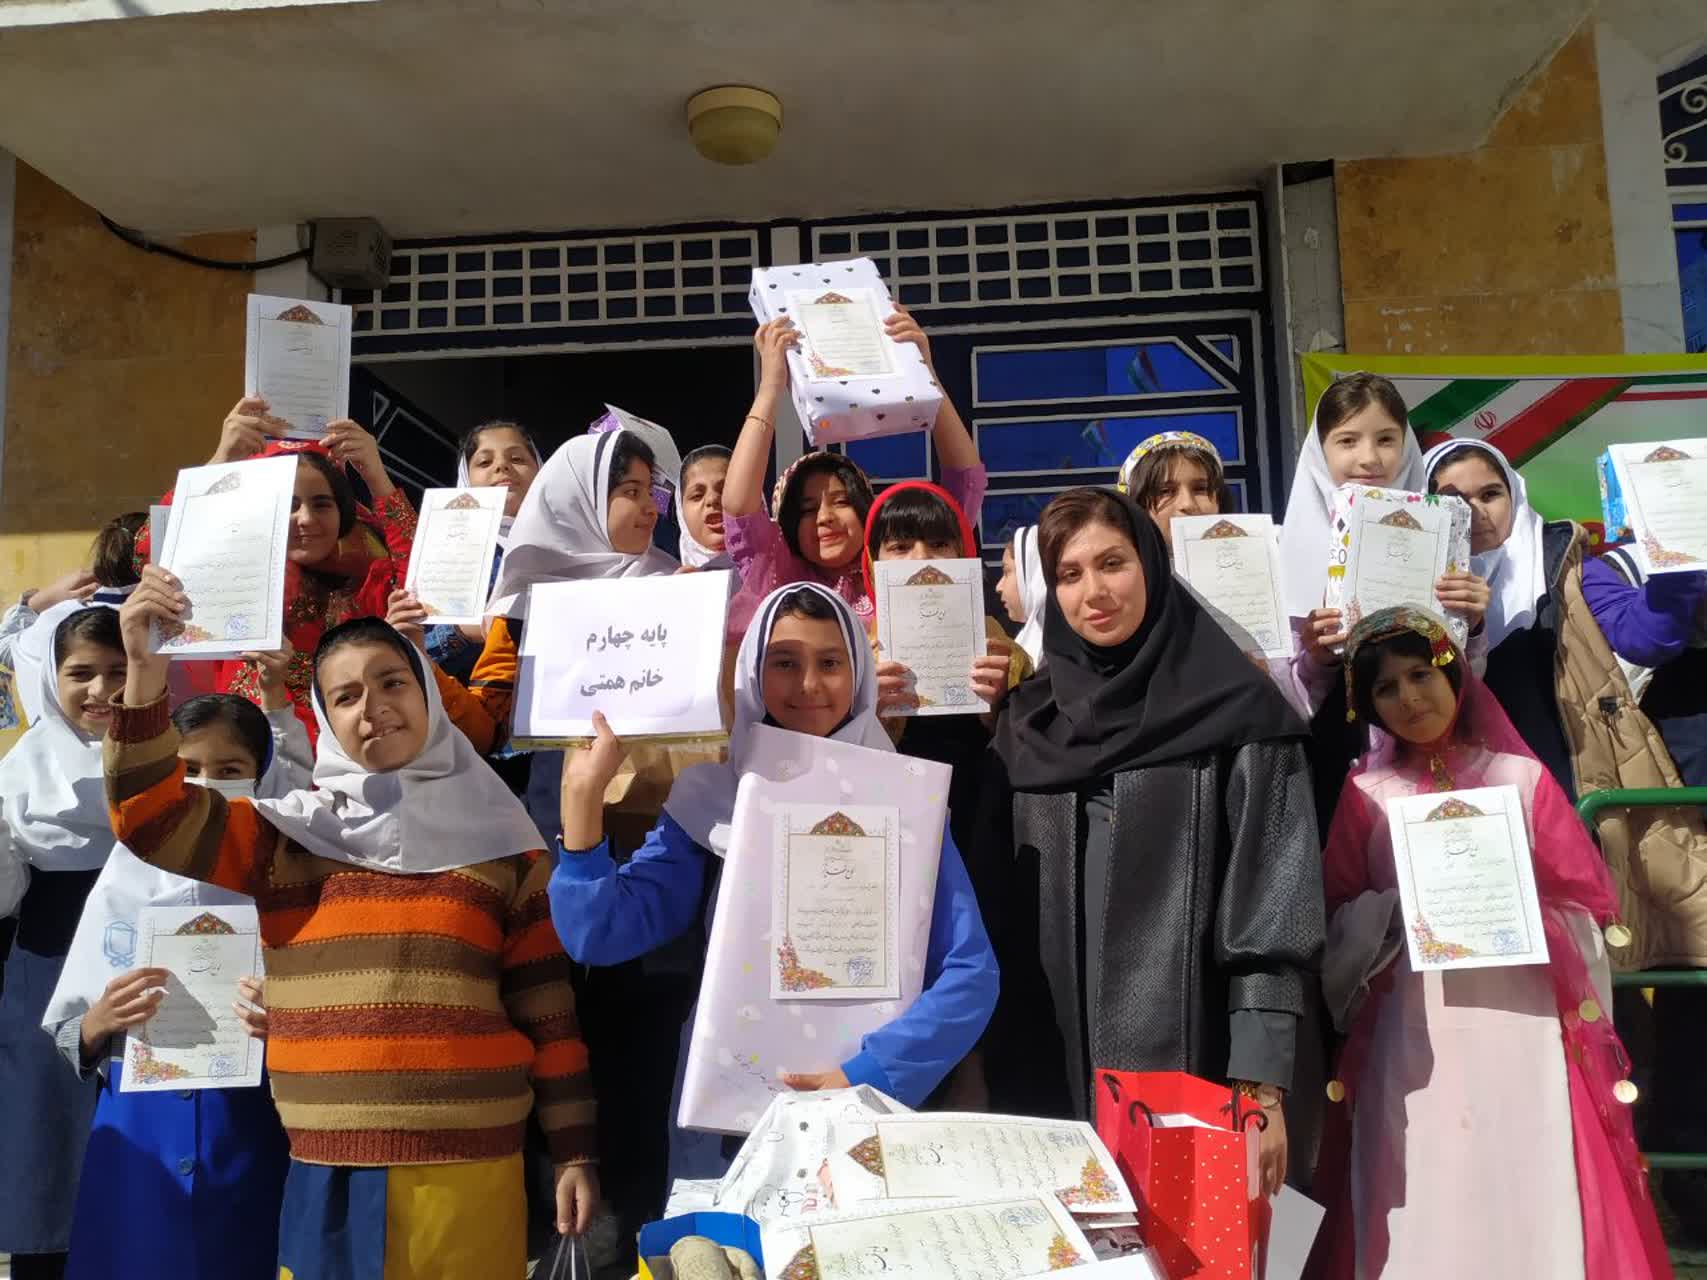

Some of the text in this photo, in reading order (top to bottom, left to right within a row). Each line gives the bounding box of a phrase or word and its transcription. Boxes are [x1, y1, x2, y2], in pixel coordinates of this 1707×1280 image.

[586, 623, 668, 652] پایه چهارم
[580, 668, 664, 698] خانم همتی
